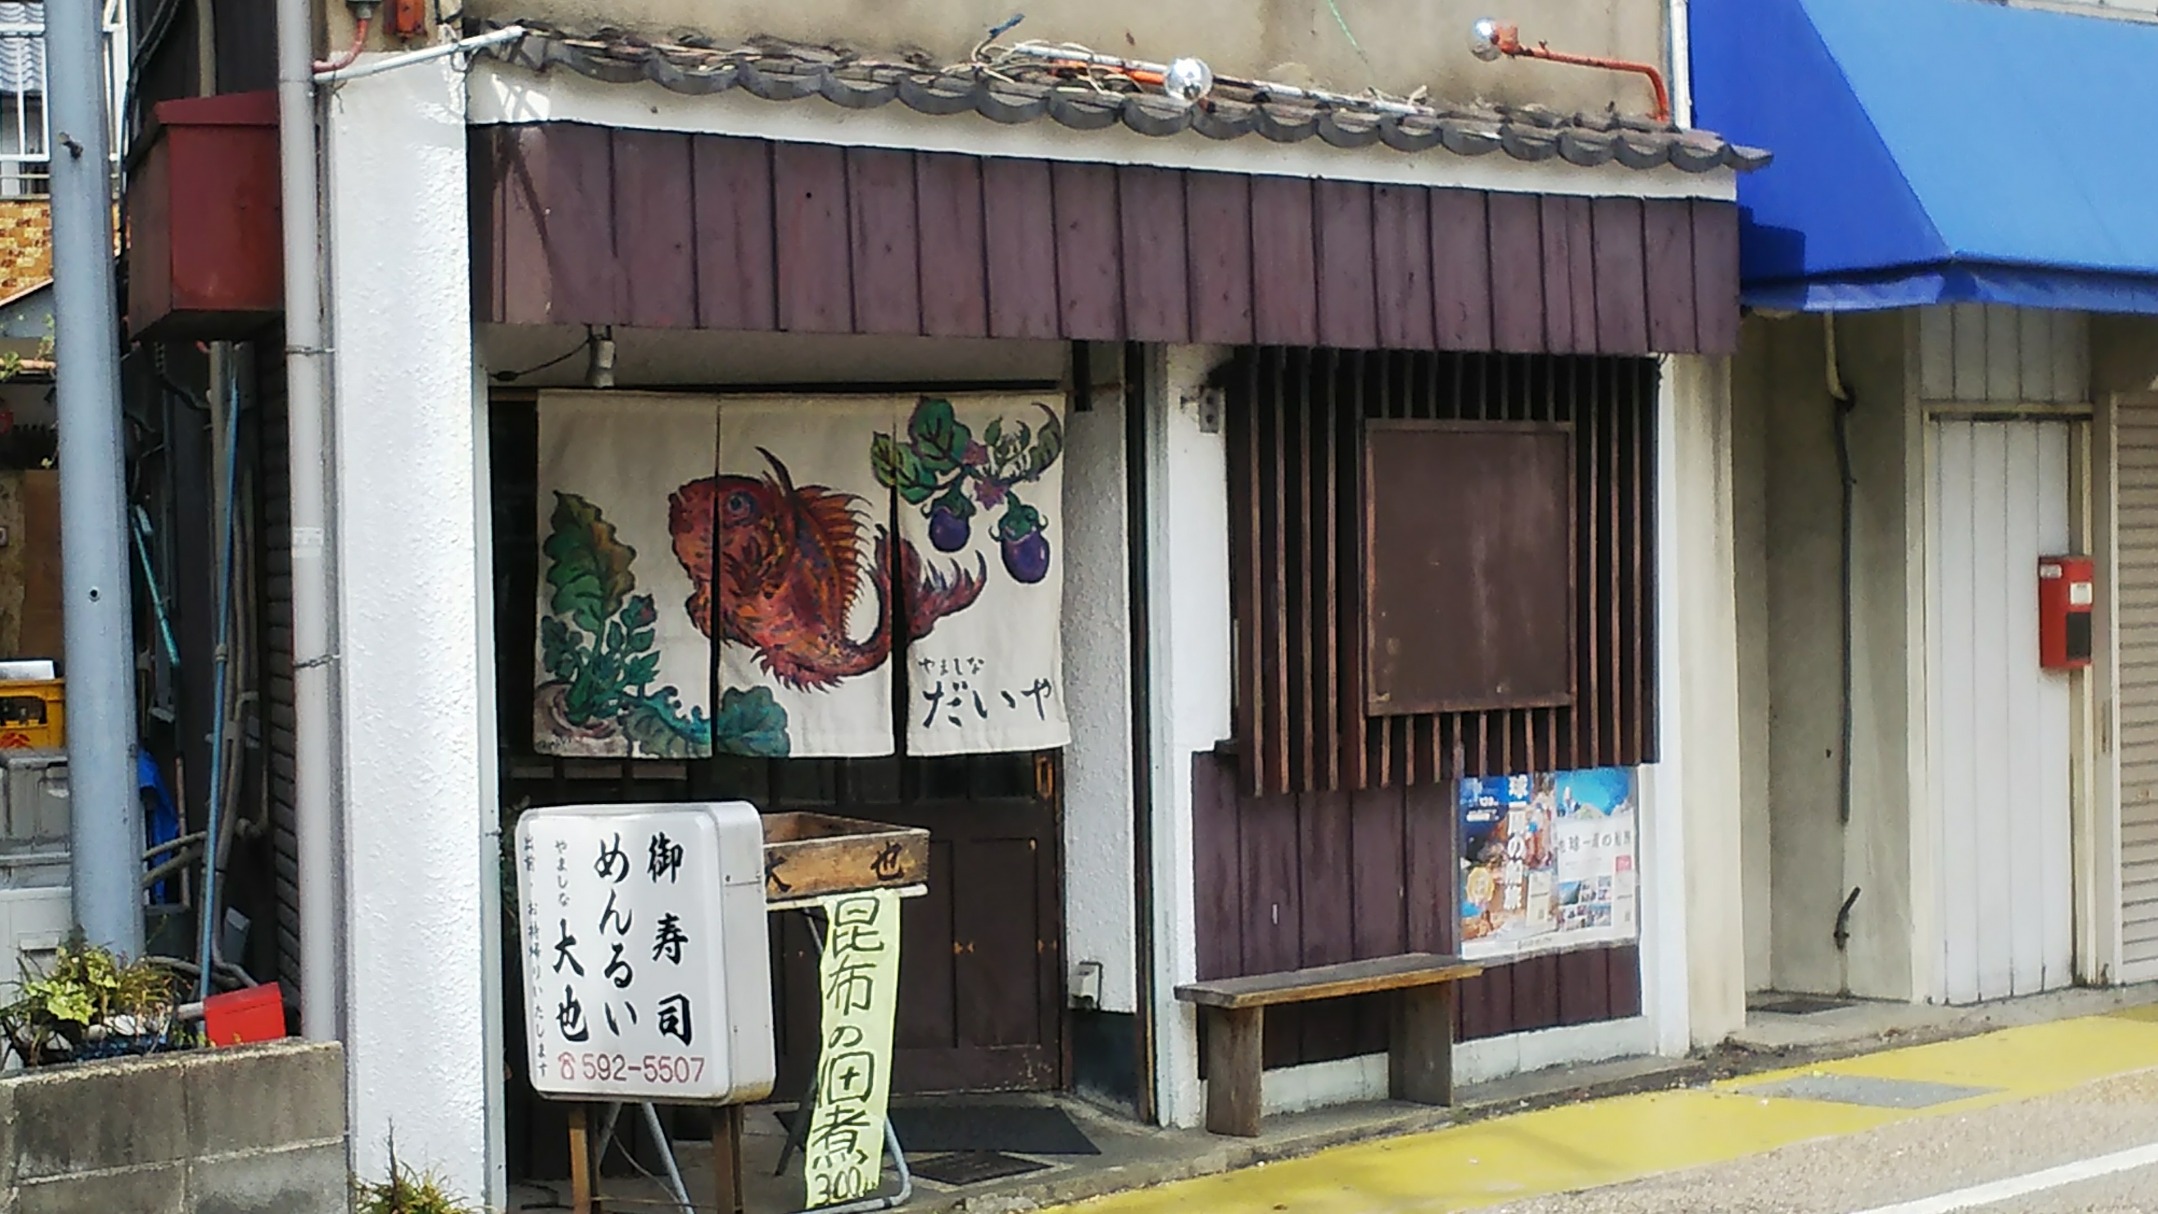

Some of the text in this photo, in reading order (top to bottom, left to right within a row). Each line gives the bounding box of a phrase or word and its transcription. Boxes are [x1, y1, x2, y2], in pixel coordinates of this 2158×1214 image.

[918, 656, 985, 676] やましな
[922, 677, 1053, 729] だいや
[552, 839, 590, 1043] やましな 大也
[593, 831, 638, 1037] めんるい
[646, 831, 693, 1047] 御寿司
[582, 1053, 706, 1084] 592-5507
